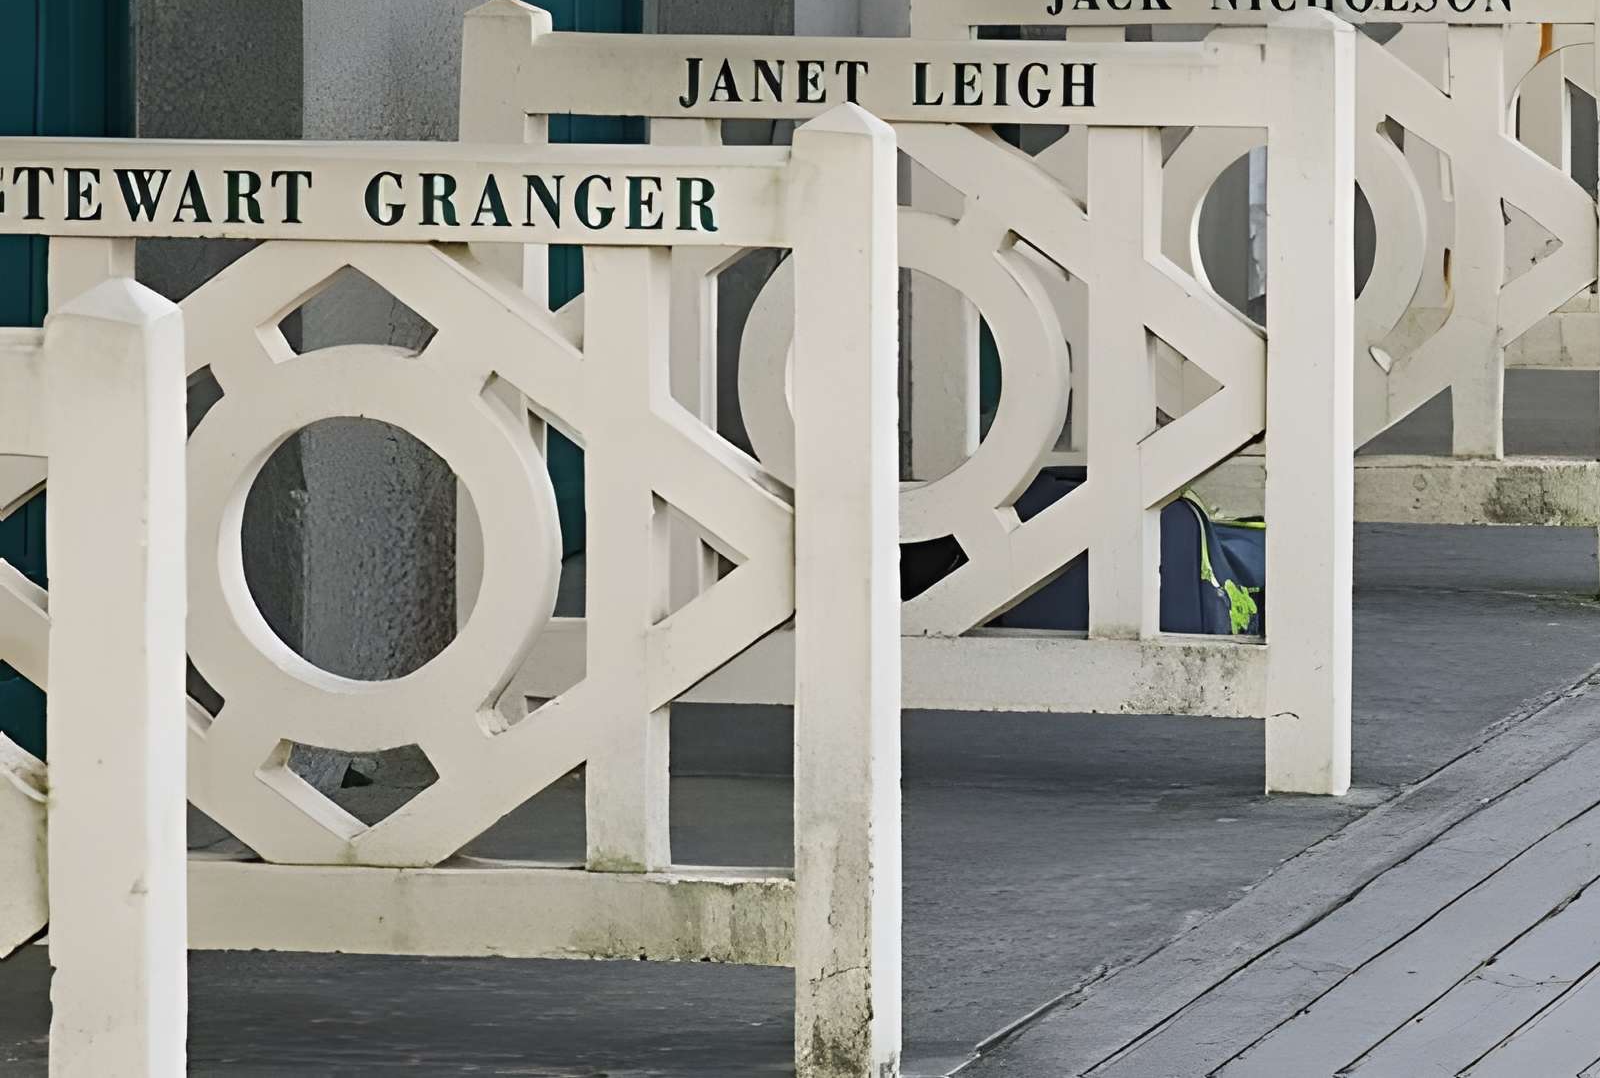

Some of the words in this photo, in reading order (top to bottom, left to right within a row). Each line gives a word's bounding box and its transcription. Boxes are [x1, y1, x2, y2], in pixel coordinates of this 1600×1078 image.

[678, 57, 869, 109] JANET
[911, 62, 1098, 109] LEIGH
[0, 166, 313, 225] TEWART
[364, 170, 719, 233] GRANGER
